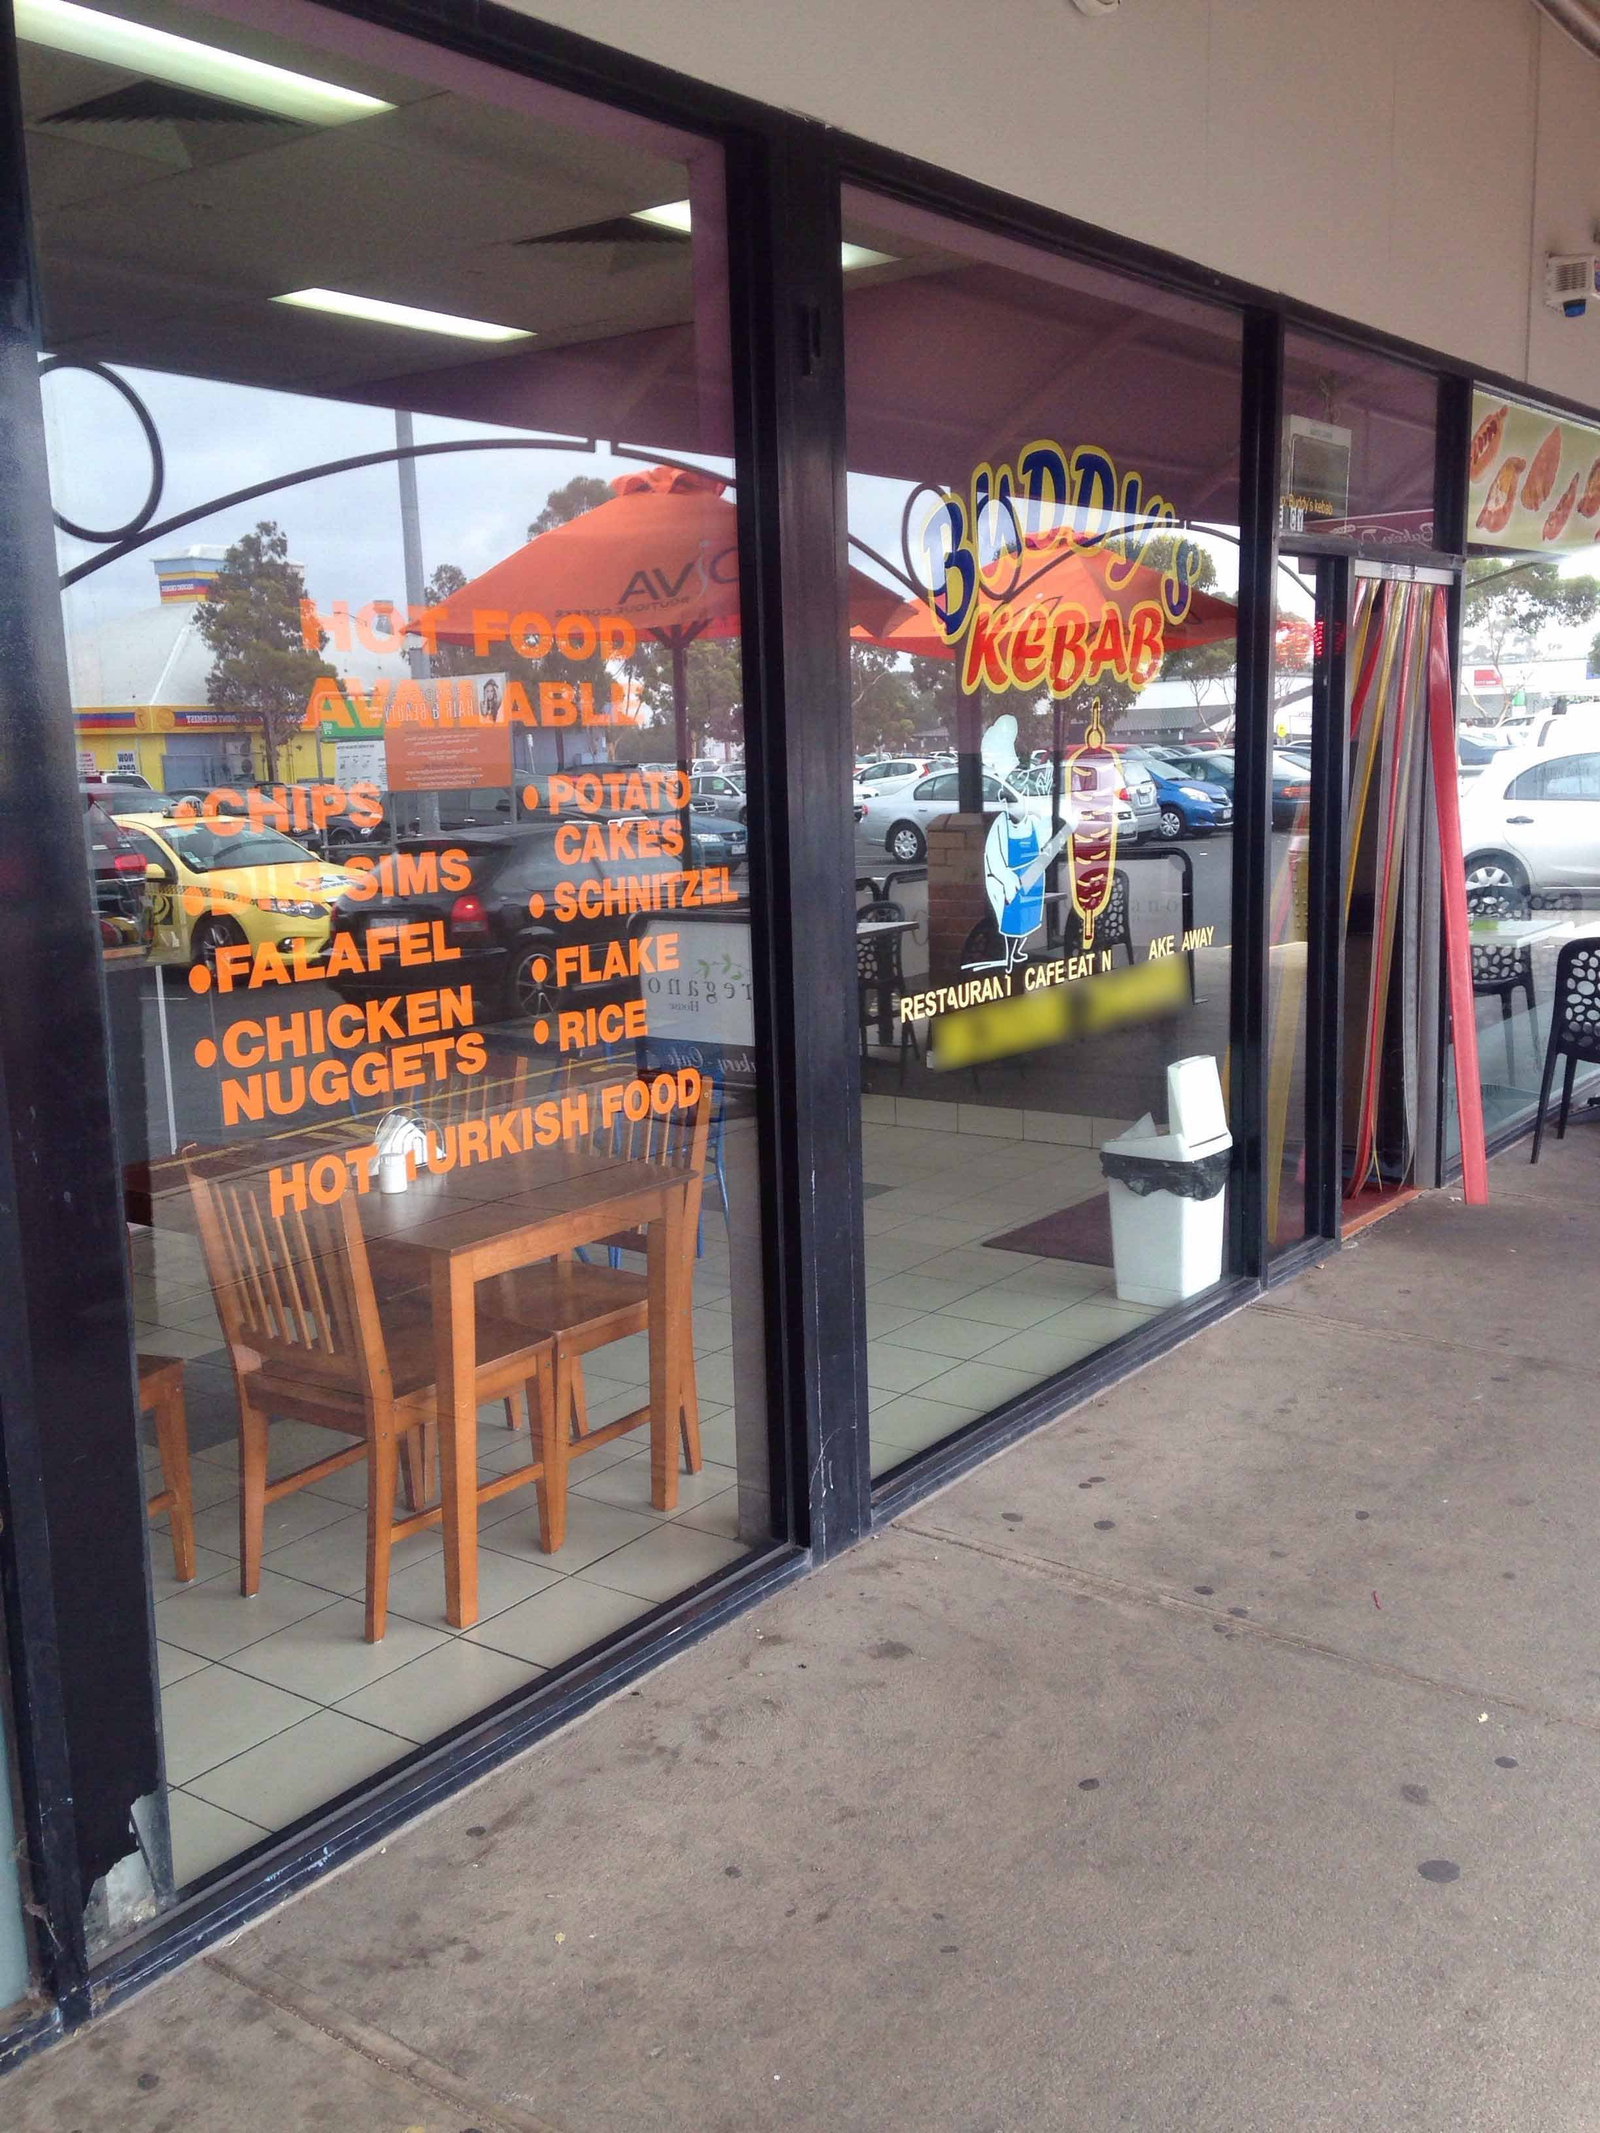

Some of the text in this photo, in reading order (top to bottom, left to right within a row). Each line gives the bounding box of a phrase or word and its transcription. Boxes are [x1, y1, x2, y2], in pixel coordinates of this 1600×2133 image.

[301, 600, 636, 661] HOT FOOD
[962, 601, 1165, 700] KEBAB
[302, 678, 646, 728] AVAILABLE
[202, 783, 384, 837] CHIPS
[549, 771, 692, 815] POTATO
[555, 819, 685, 865] CAKES
[342, 848, 473, 902] SIMS
[554, 867, 739, 922] SCHNITZEL
[214, 920, 462, 993] FALAFEL
[556, 932, 680, 988] FLAKE
[1024, 959, 1066, 992] CAFE
[1067, 952, 1097, 981] EAT
[1181, 926, 1215, 951] AWAY
[221, 984, 474, 1069] CHICKEN
[558, 999, 648, 1052] RICE
[220, 1031, 488, 1125] NUGGETS
[269, 1144, 379, 1219] HOT
[602, 1067, 702, 1129] FOOD
